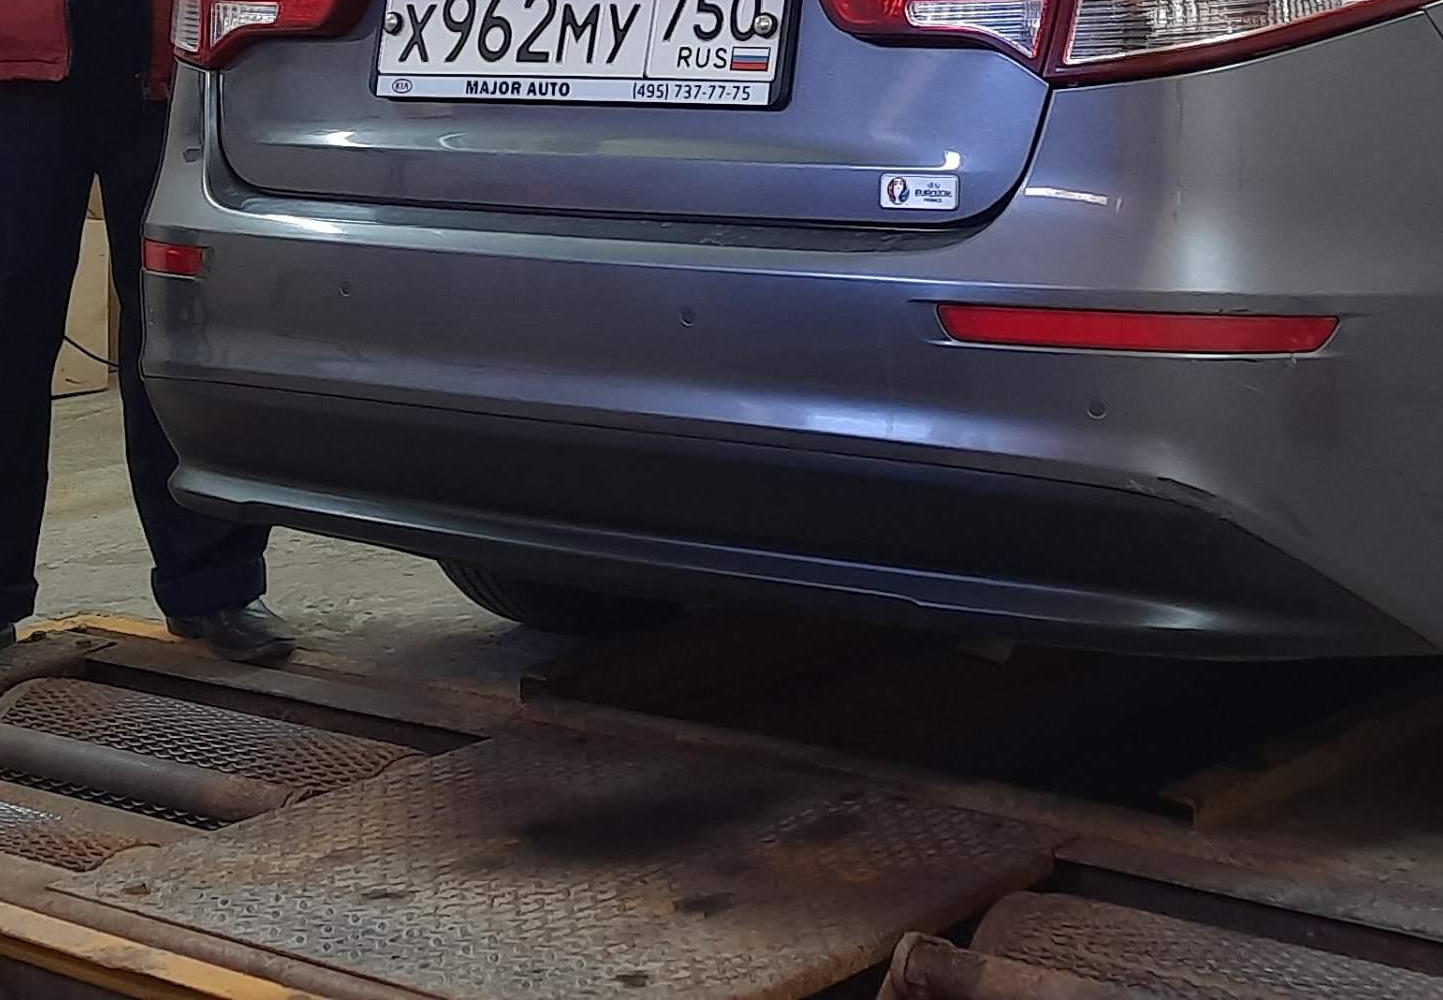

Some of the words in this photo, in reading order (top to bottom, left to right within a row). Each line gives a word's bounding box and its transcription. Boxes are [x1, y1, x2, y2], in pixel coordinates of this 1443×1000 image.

[676, 46, 728, 69] RUS
[465, 80, 522, 96] MAJOR
[526, 81, 570, 97] AUTO
[632, 82, 669, 101] (495)
[674, 84, 751, 101] 737-77-75
